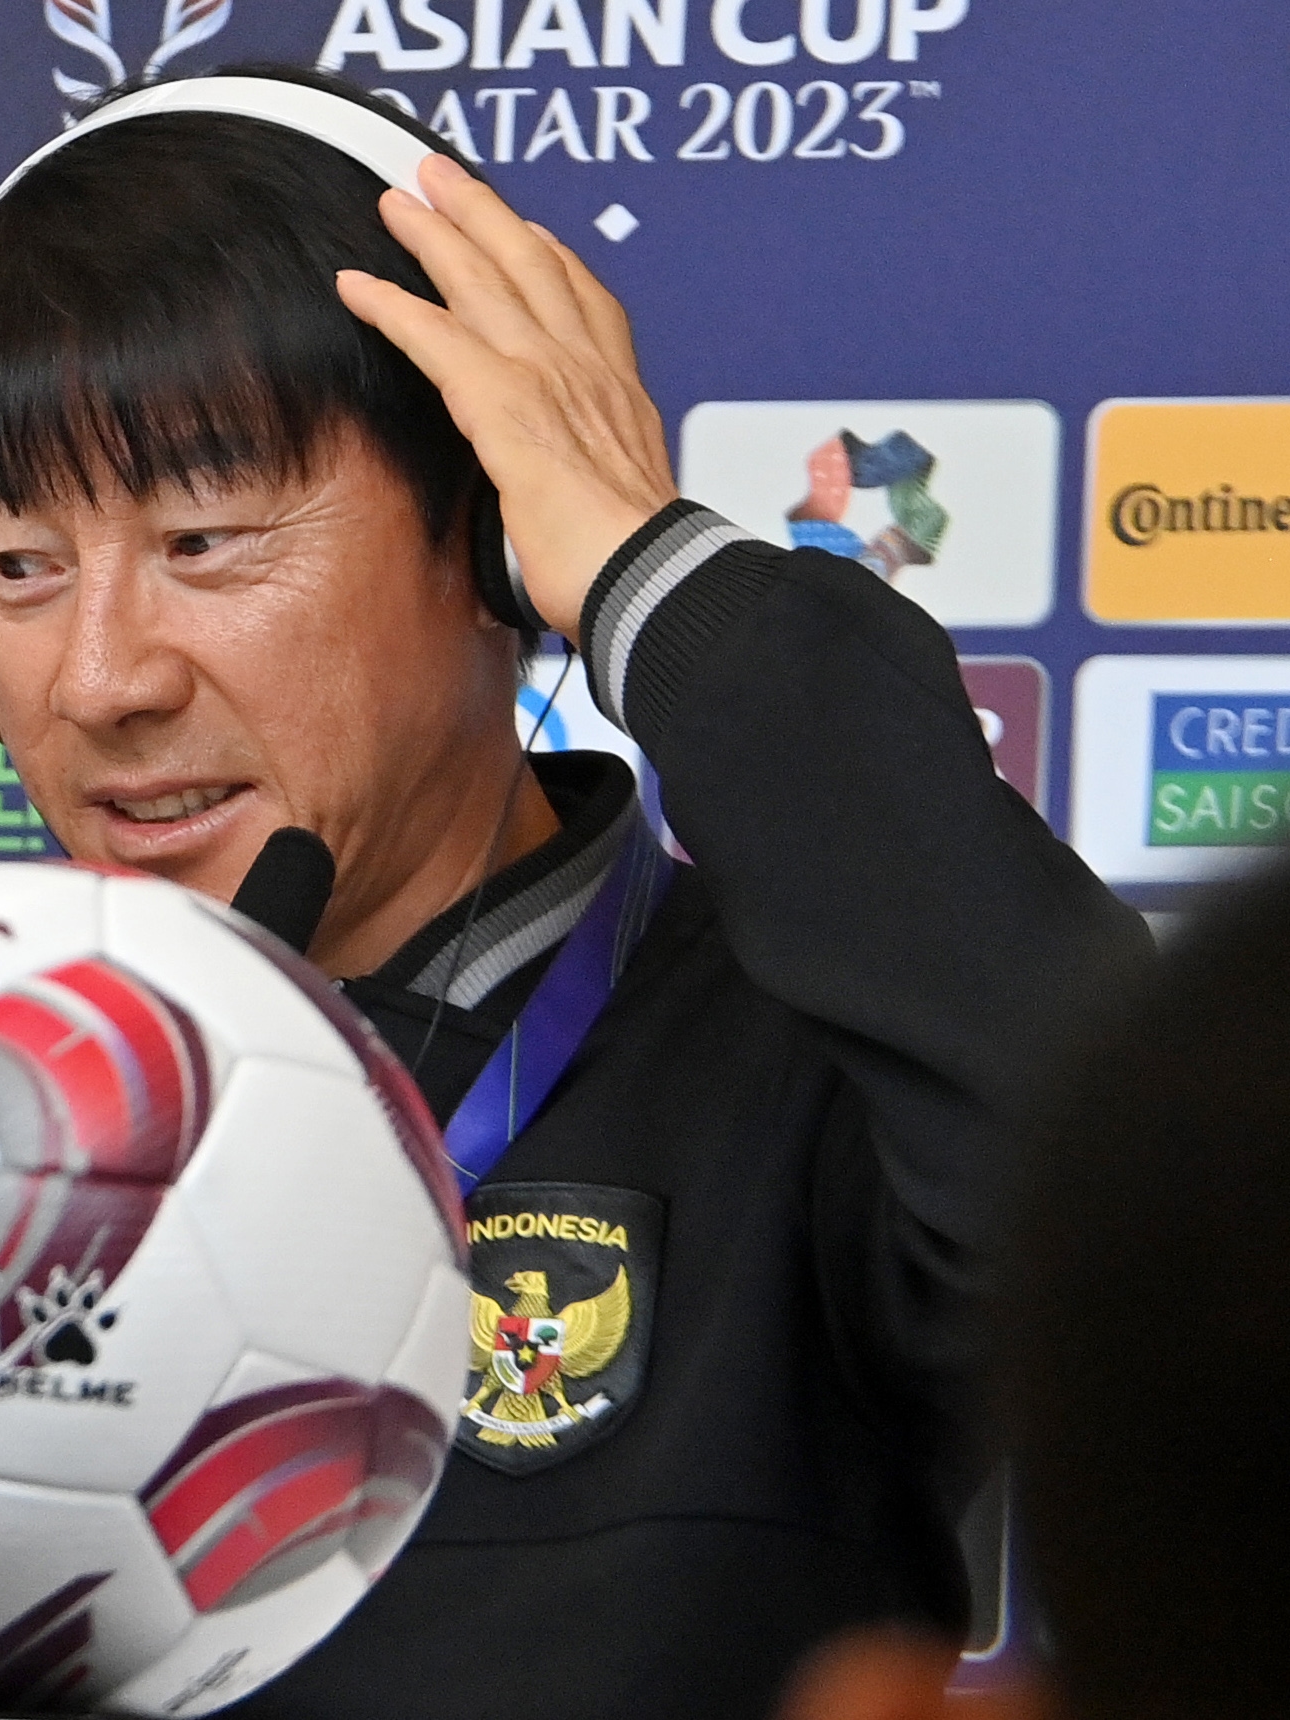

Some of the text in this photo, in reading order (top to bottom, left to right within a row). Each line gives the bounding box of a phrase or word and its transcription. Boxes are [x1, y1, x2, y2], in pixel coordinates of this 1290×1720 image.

[314, 0, 972, 71] ASIAN CUP
[676, 79, 907, 162] 2023
[465, 1212, 629, 1252] INDONESIA
